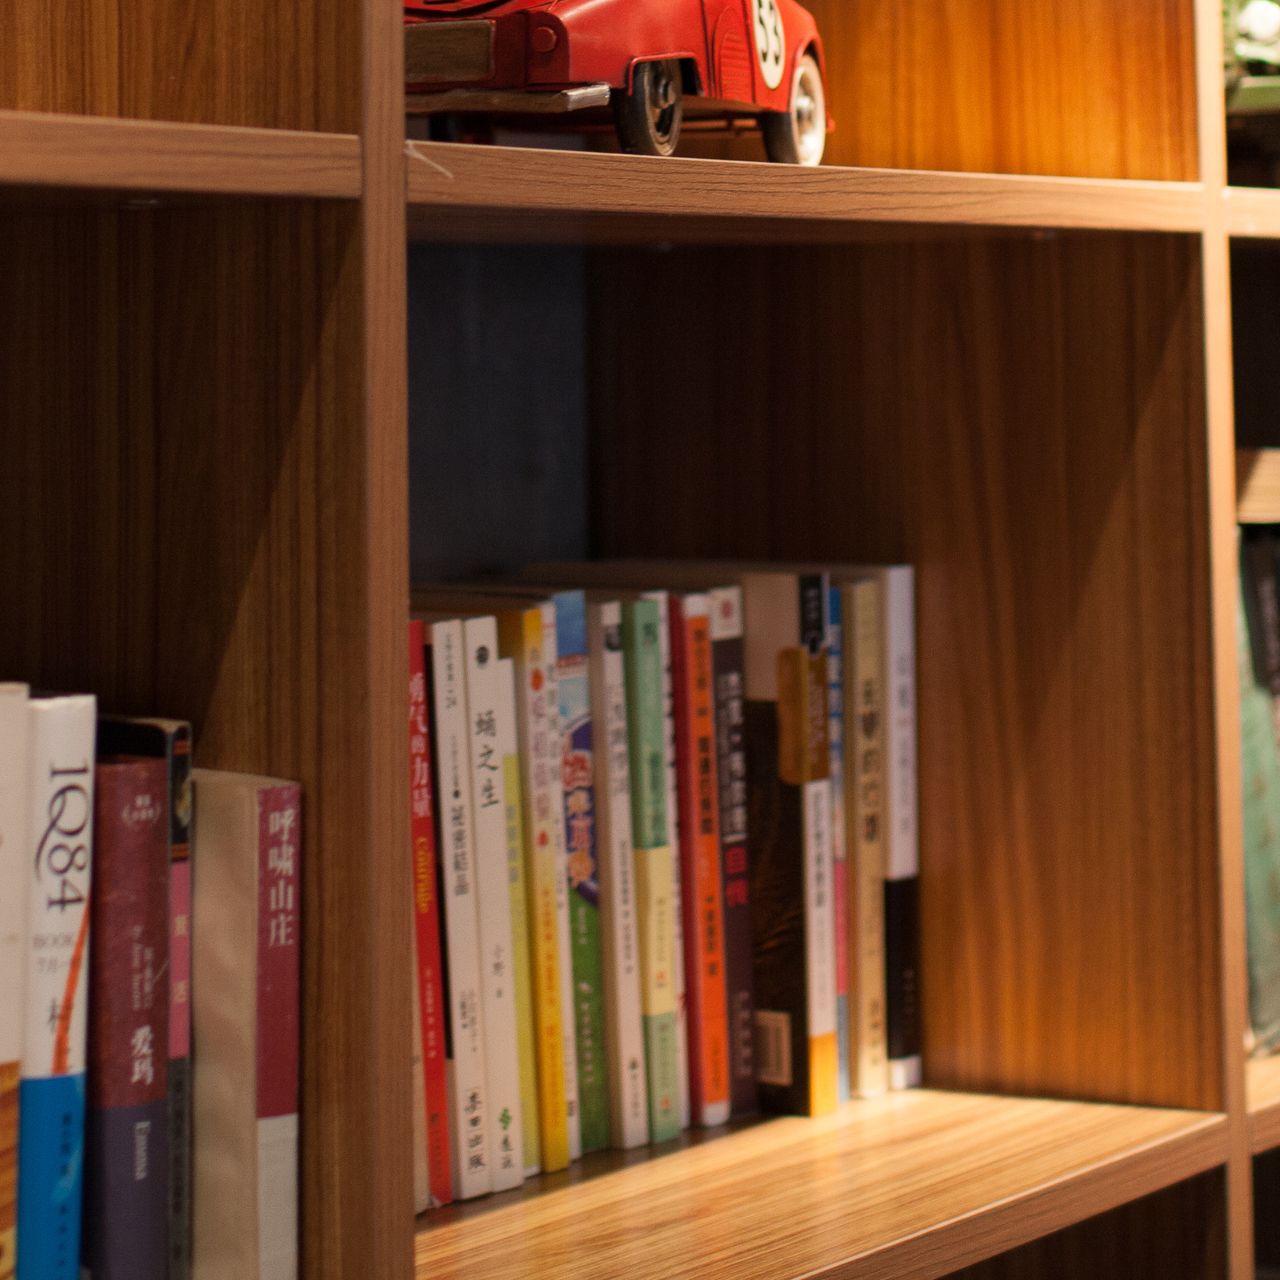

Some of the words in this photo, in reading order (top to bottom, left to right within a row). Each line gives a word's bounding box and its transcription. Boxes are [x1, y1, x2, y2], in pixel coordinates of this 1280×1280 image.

[35, 762, 90, 914] 1Q84
[268, 807, 297, 947] 呼啸山庄
[130, 1024, 155, 1087] 爱玛
